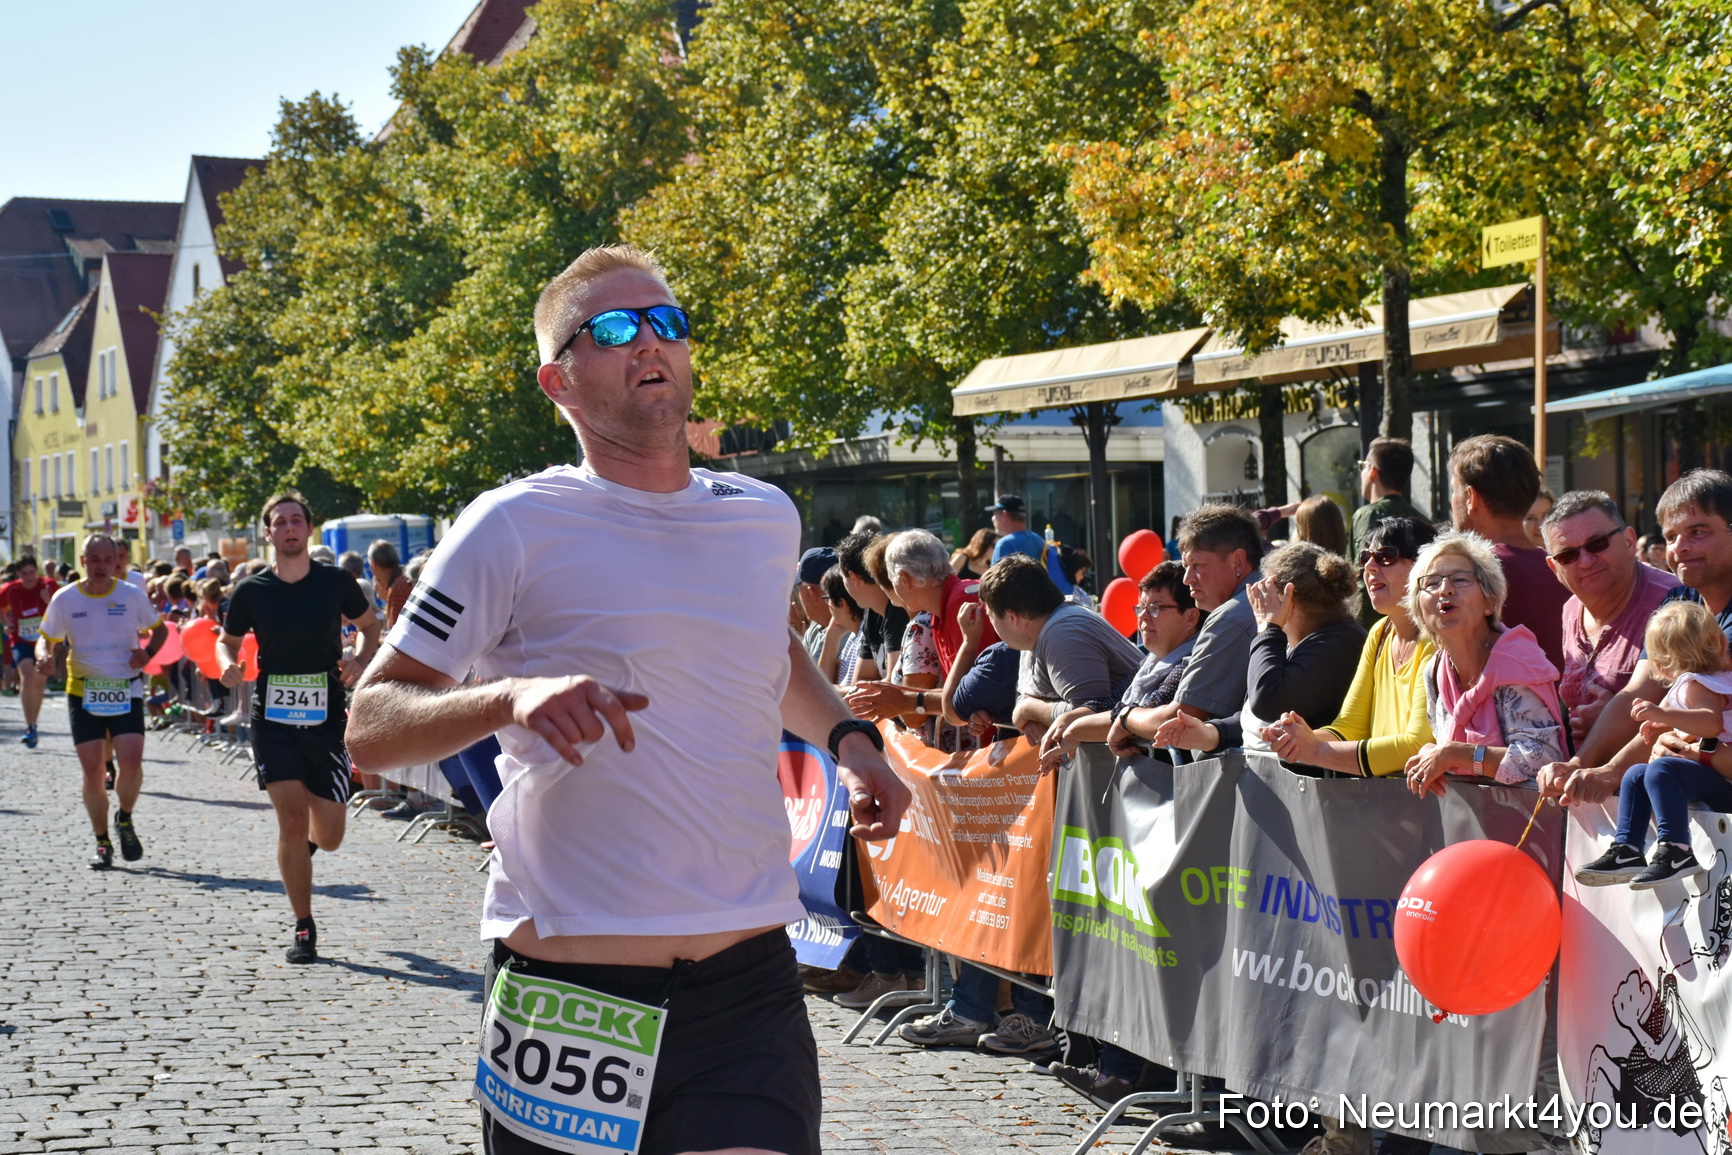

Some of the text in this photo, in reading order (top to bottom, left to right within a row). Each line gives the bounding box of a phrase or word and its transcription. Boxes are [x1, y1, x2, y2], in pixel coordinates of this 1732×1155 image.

[1493, 232, 1537, 253] Toiletten
[712, 488, 744, 496] adidas
[272, 674, 323, 687] BOCK
[89, 691, 126, 703] 3000
[274, 689, 320, 707] 2341
[287, 711, 306, 719] JAN
[970, 774, 1005, 788] moderner
[1006, 773, 1039, 786] Partner
[956, 794, 994, 810] Konzeption
[995, 792, 1011, 805] und
[966, 812, 1000, 827] Projekte
[1000, 815, 1014, 825] was
[889, 878, 947, 917] Agentur
[995, 914, 1010, 930] 897
[1405, 910, 1435, 923] energie
[499, 981, 637, 1042] BOCK
[490, 1019, 630, 1104] 2056
[636, 1067, 645, 1077] B
[485, 1075, 621, 1143] CHRISTIAN
